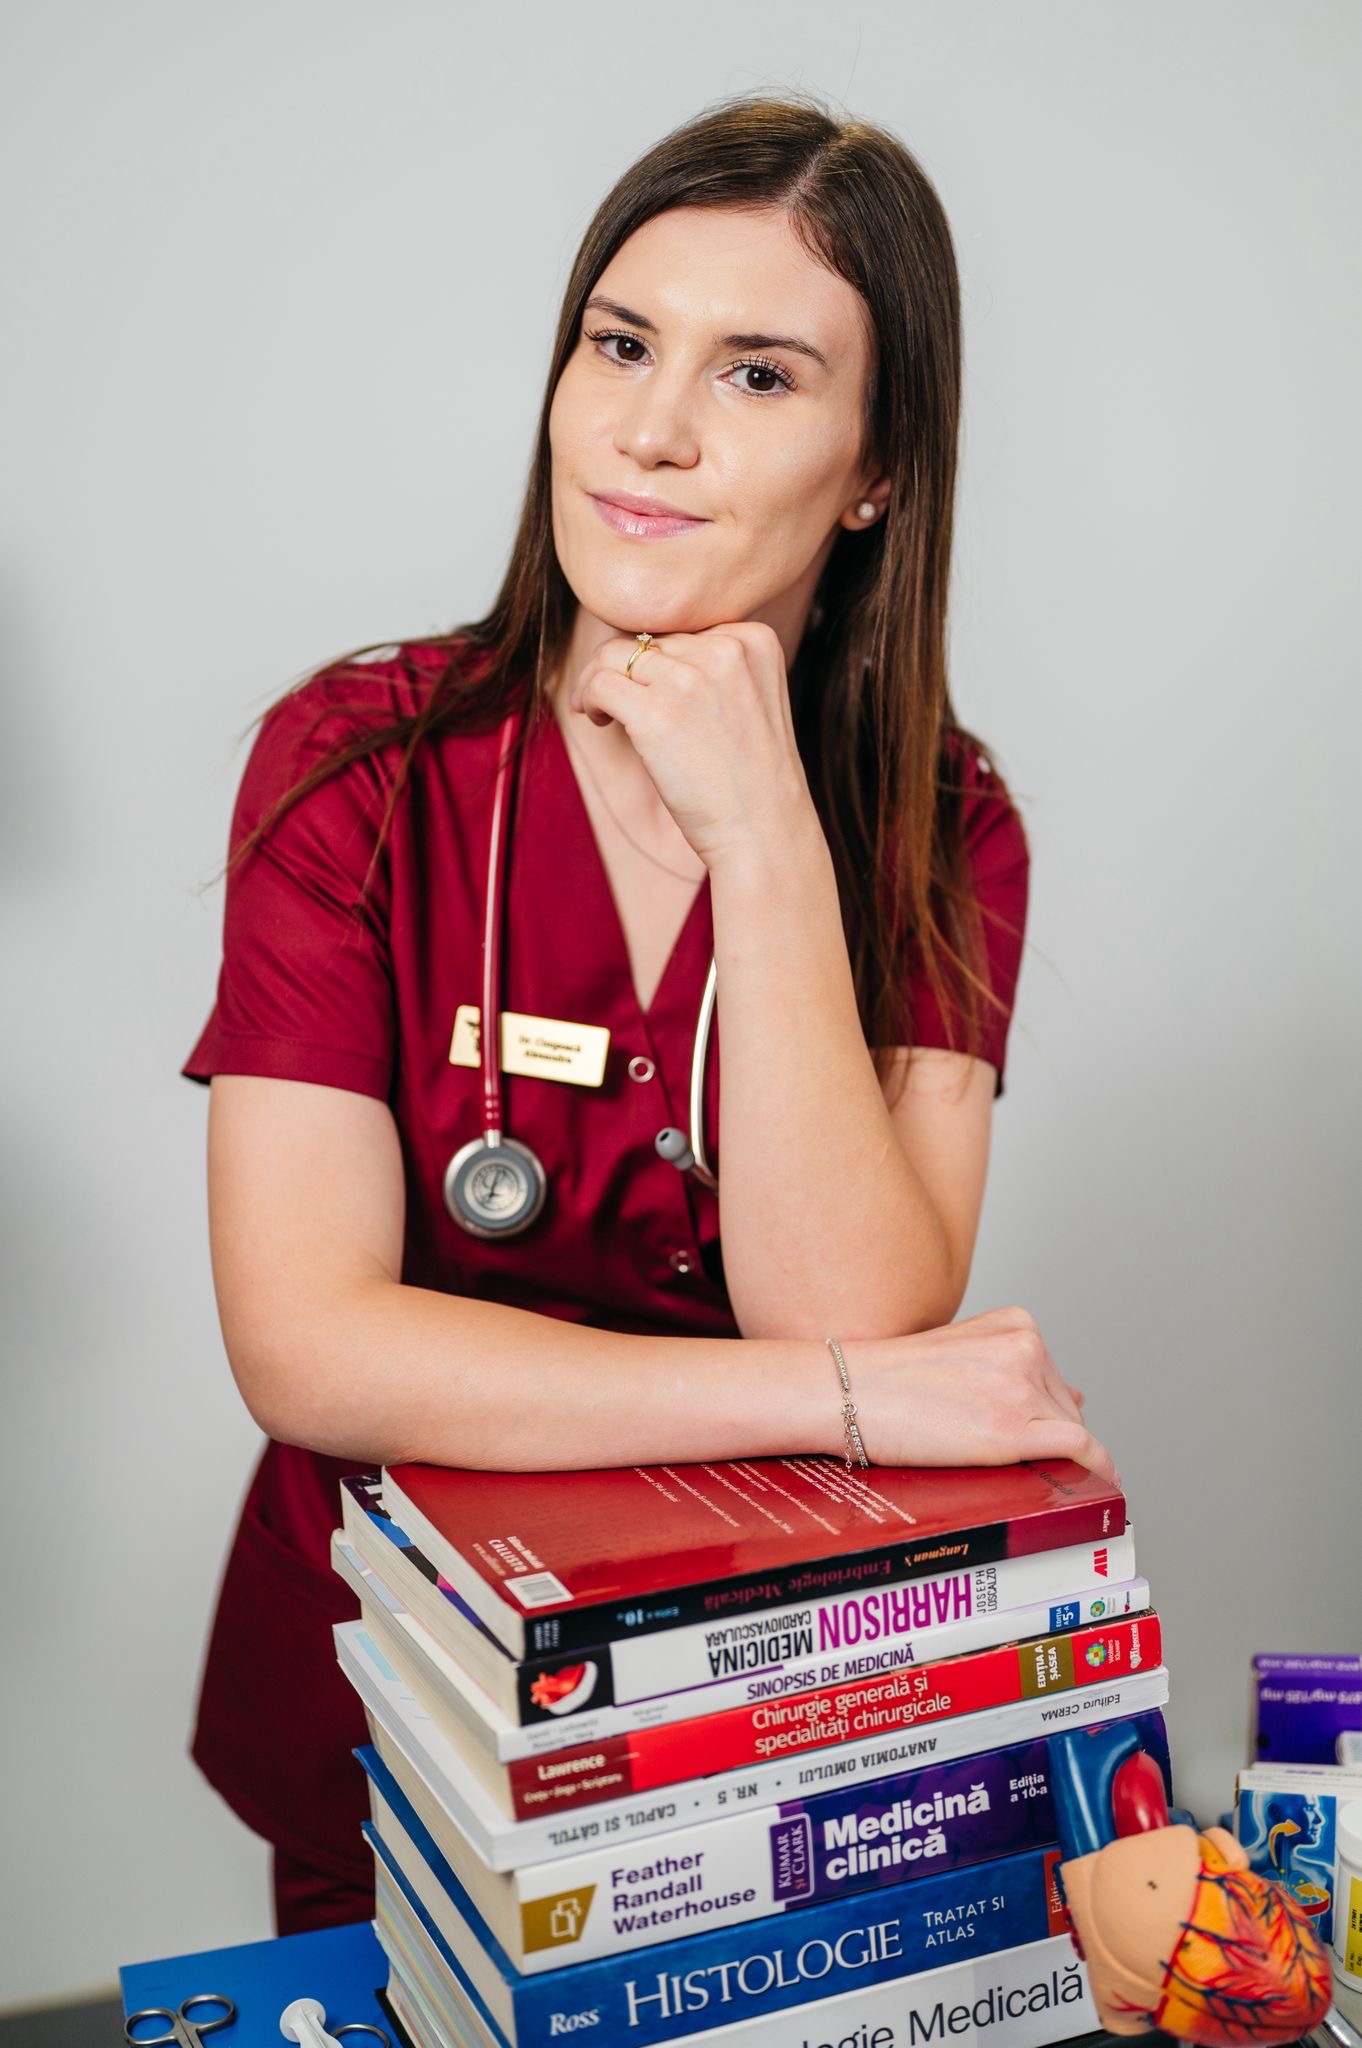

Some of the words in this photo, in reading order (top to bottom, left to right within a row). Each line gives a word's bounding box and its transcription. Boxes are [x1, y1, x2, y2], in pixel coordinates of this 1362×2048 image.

[1102, 1508, 1111, 1533] Sadler
[488, 1539, 528, 1572] CALLISTO
[904, 1543, 969, 1567] Langman's
[1093, 1548, 1108, 1577] ALL
[788, 1559, 891, 1593] Embriologie
[975, 1569, 986, 1614] JOSEPH
[986, 1567, 997, 1612] LOSCALZO
[704, 1582, 783, 1612] Medicală
[819, 1573, 972, 1651] HARRISON
[704, 1609, 811, 1648] CARDIOVASCULARA
[708, 1628, 814, 1678] MEDICINA
[1035, 1645, 1044, 1655] A
[1048, 1646, 1061, 1682] ȘASEA
[747, 1670, 816, 1700] SINOPSIS
[821, 1665, 841, 1683] DE
[845, 1643, 915, 1678] MEDICINĂ
[1036, 1655, 1048, 1688] EDIȚIA
[752, 1696, 832, 1729] Chirurgie
[836, 1677, 911, 1713] generală
[914, 1671, 929, 1695] și
[1042, 1704, 1078, 1721] CERMA
[1083, 1694, 1120, 1710] Editura
[754, 1712, 850, 1757] specialități
[854, 1692, 952, 1730] chirurgicale
[537, 1754, 606, 1781] Lawrence
[862, 1738, 938, 1768] ANATOMIA
[800, 1757, 857, 1784] OMULUI
[1009, 1773, 1045, 1792] Ediția
[717, 1790, 727, 1805] 5
[735, 1783, 759, 1801] NR.
[1010, 1793, 1019, 1803] a
[1022, 1784, 1048, 1800] 10-a
[626, 1802, 676, 1829] CAPUL
[823, 1782, 990, 1851] Medicină
[548, 1822, 600, 1847] GÂTUL
[791, 1824, 805, 1877] CLARK
[610, 1852, 704, 1888] Feather
[777, 1833, 789, 1890] KUMAR
[825, 1827, 946, 1881] clinică
[613, 1873, 703, 1913] Randall
[613, 1888, 756, 1935] Waterhouse
[923, 1900, 987, 1928] TRATAT
[992, 1895, 1005, 1911] SI
[925, 1923, 975, 1948] ATLAS
[625, 1920, 903, 2027] HISTOLOGIE
[908, 1964, 1084, 2045] Medicală
[549, 2008, 600, 2036] Ross
